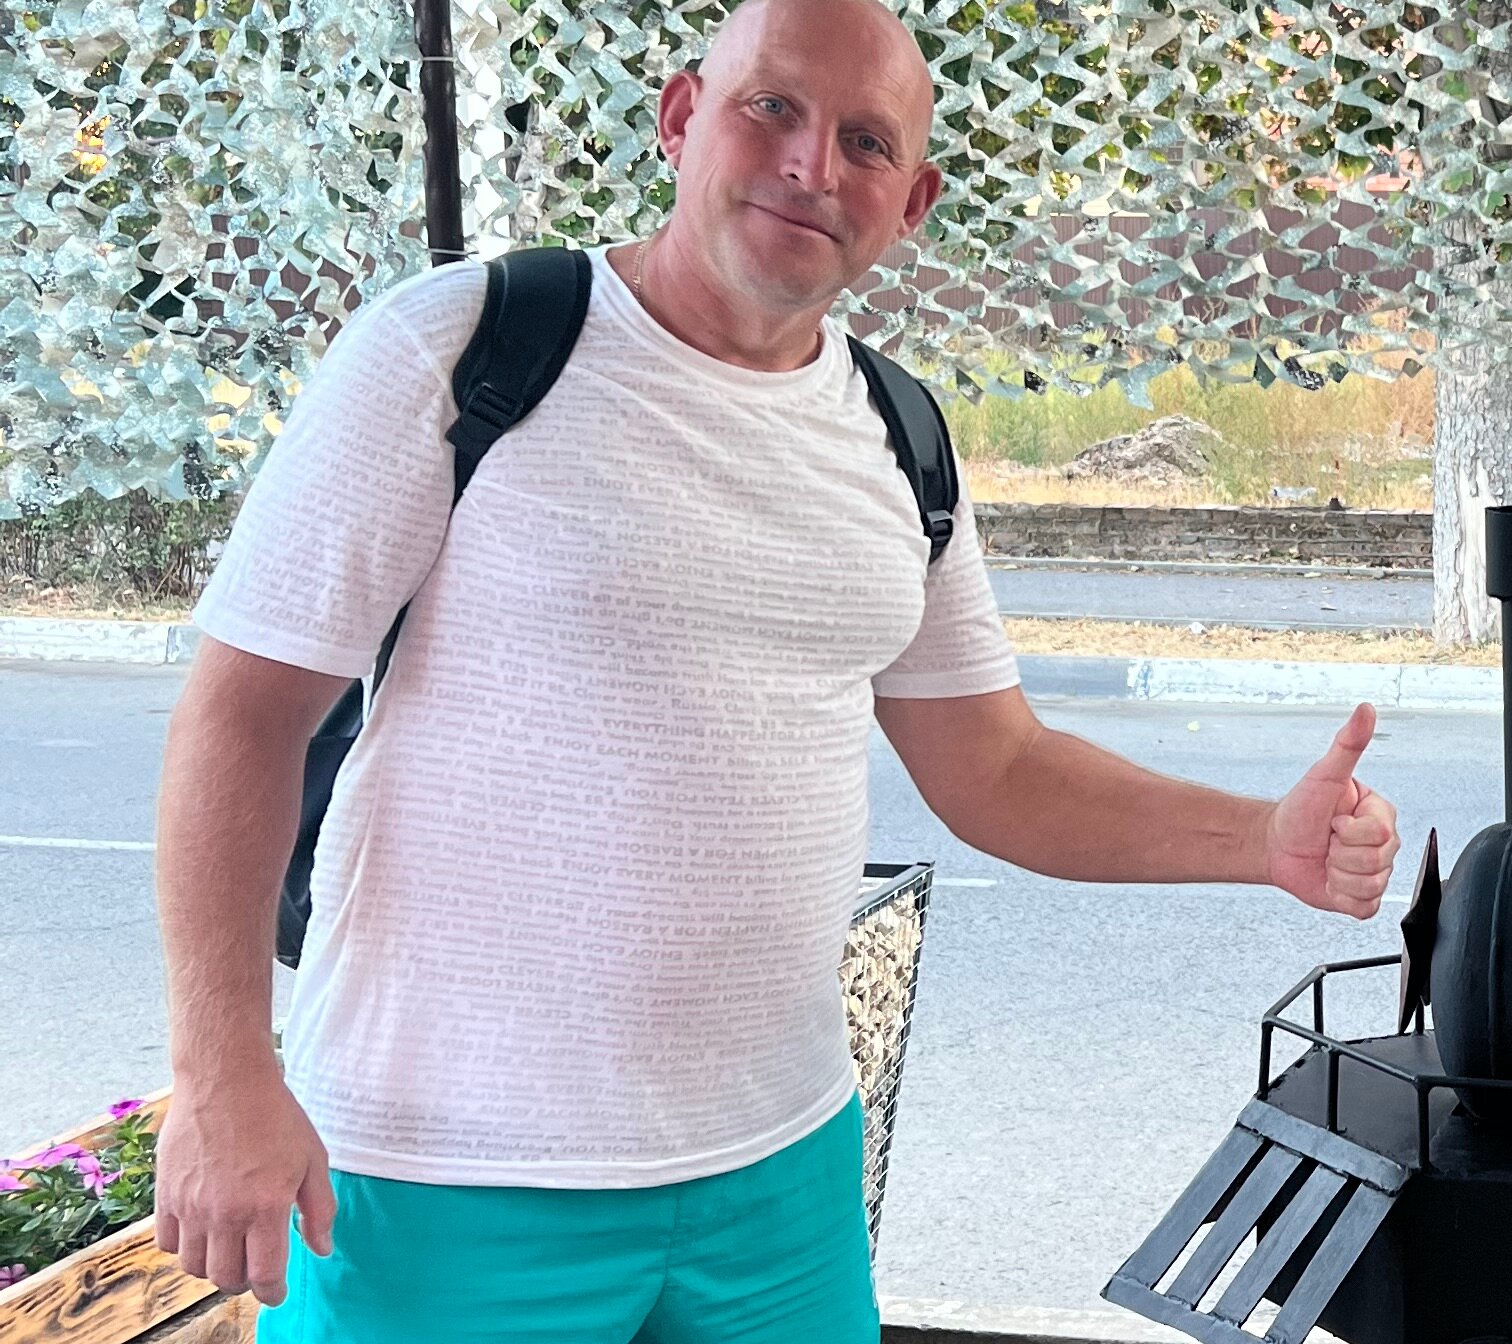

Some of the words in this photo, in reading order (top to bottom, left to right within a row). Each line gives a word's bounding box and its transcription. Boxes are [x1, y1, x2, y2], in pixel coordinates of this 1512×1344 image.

[602, 717, 706, 738] EVERYTHING
[542, 735, 594, 754] ENJOY
[596, 743, 641, 759] EACH
[642, 748, 721, 767] MOMENT
